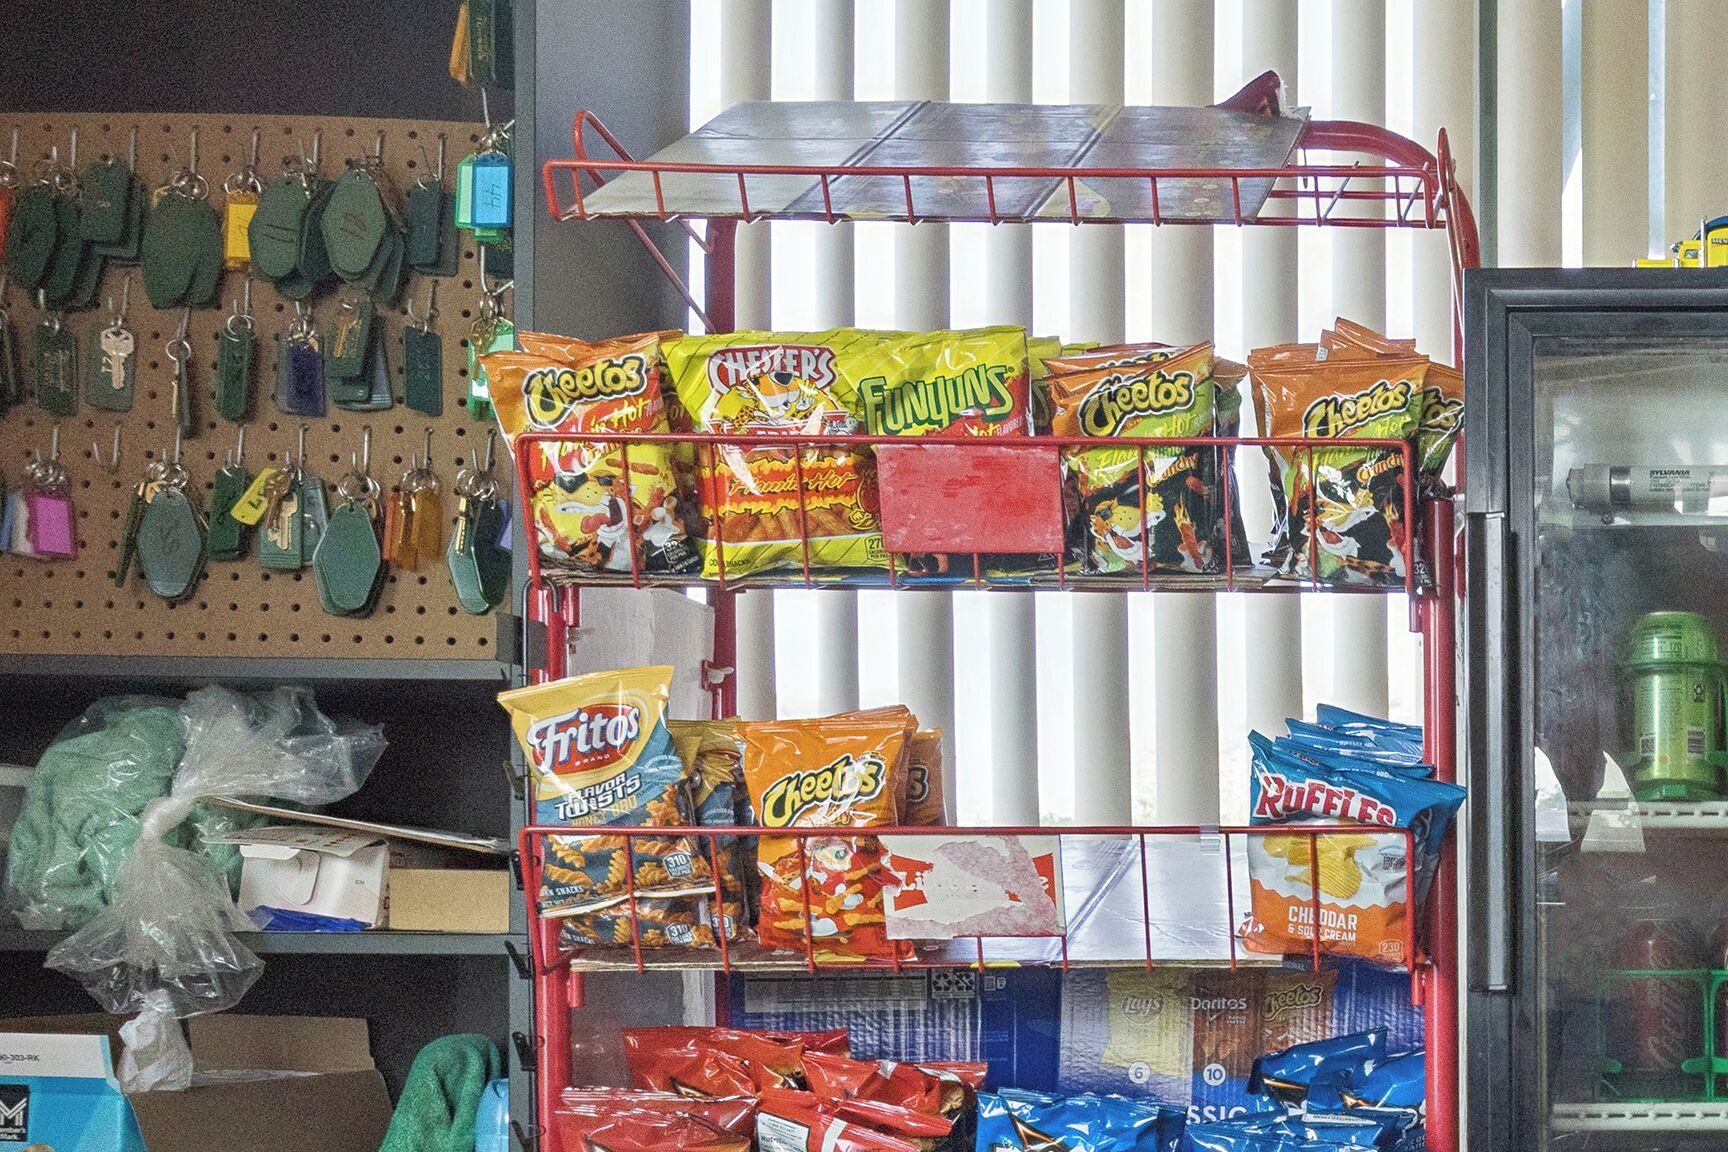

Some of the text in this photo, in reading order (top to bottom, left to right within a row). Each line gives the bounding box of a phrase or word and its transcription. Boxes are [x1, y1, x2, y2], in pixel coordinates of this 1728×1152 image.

[708, 346, 837, 395] CHESTER'S
[524, 356, 647, 428] Cheetos
[859, 364, 1014, 436] FUNYUNS
[1079, 371, 1194, 437] Cheetos
[1303, 380, 1415, 438] Cheetos
[1356, 452, 1404, 483] Crunch
[808, 469, 858, 491] Hot
[526, 704, 640, 769] Fritos
[575, 753, 610, 766] BRAND
[761, 753, 886, 827] Cheets
[1253, 772, 1397, 827] RUFFLES
[667, 854, 687, 867] 310
[555, 886, 585, 897] SNACKS
[669, 924, 689, 937] 310
[1288, 923, 1295, 934] &
[1324, 928, 1357, 942] CREAM
[1381, 942, 1400, 953] 230
[1190, 997, 1248, 1011] Doritos
[1134, 1066, 1144, 1079] 6
[1207, 1067, 1223, 1081] 10
[1186, 1105, 1248, 1125] SSIC
